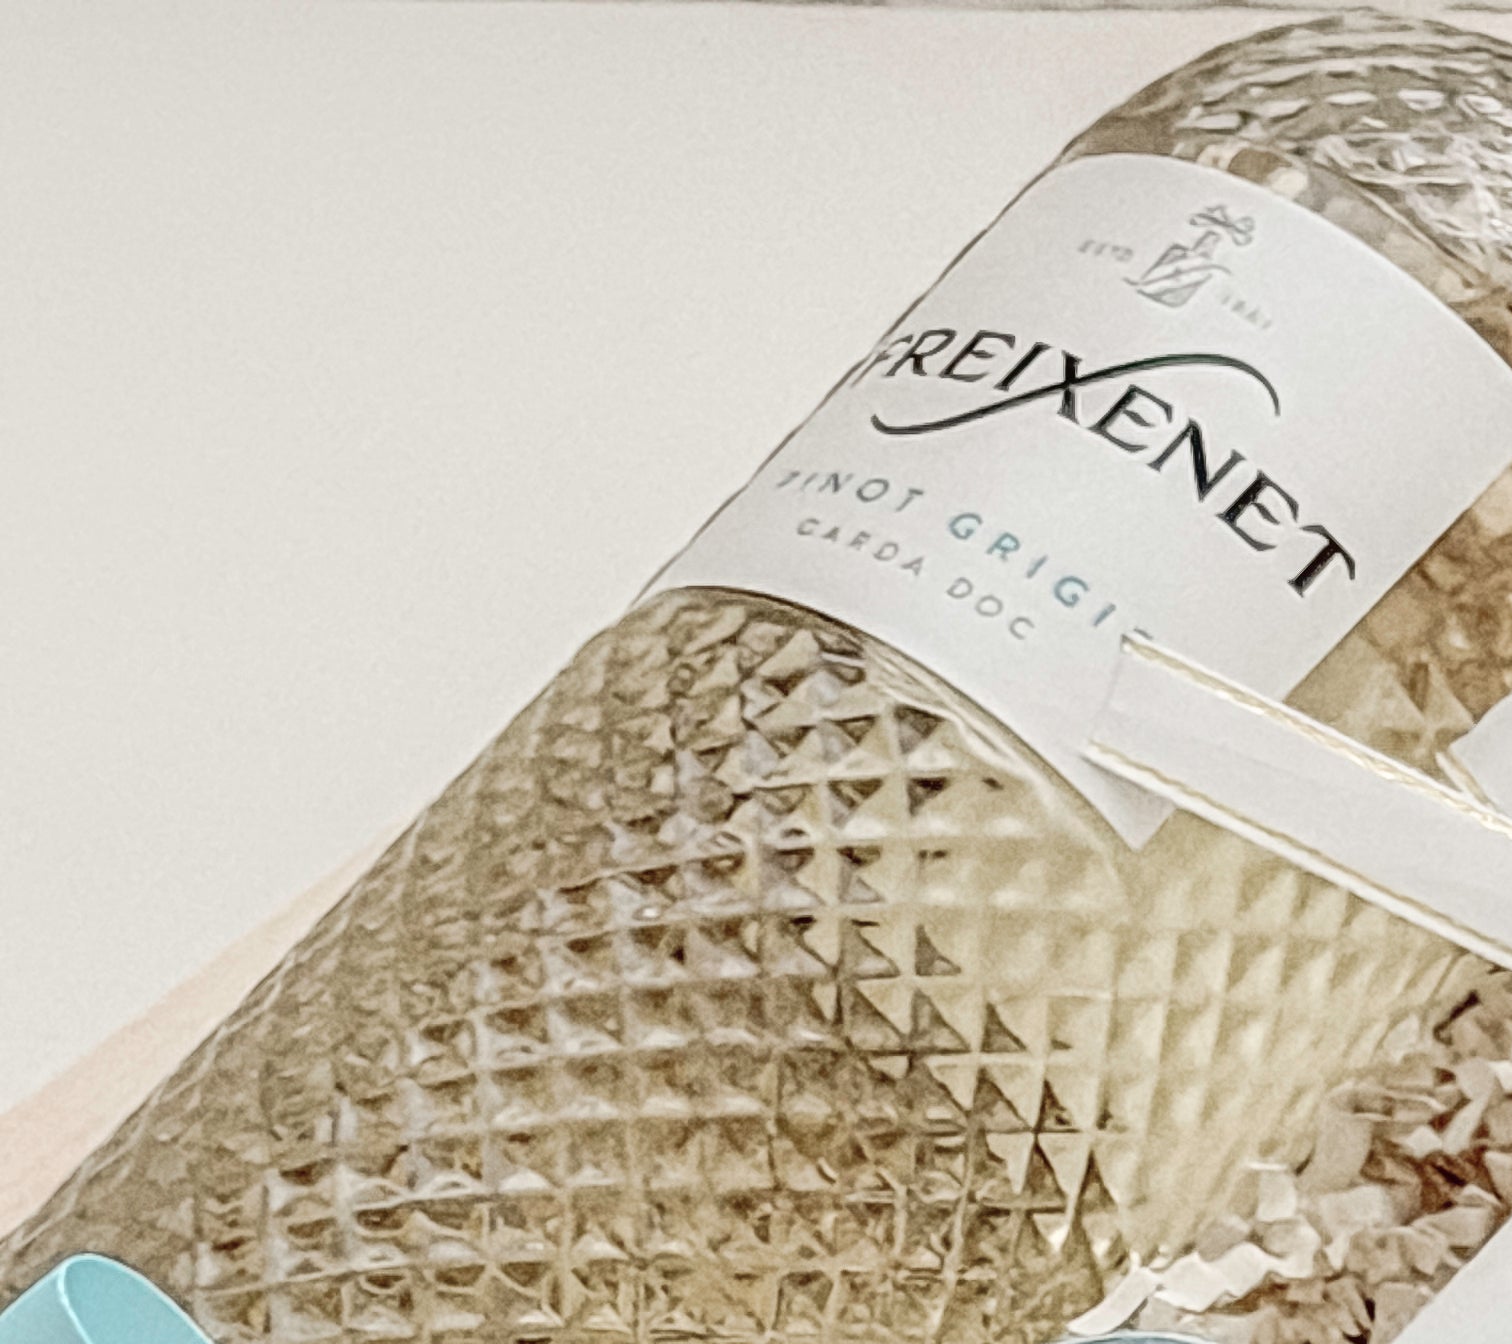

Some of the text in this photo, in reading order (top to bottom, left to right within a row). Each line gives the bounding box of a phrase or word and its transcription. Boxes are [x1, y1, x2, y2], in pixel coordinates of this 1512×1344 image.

[852, 328, 1356, 598] FREIXENET
[796, 518, 1035, 641] GARDA DOC
[948, 512, 1153, 641] GRIGI
